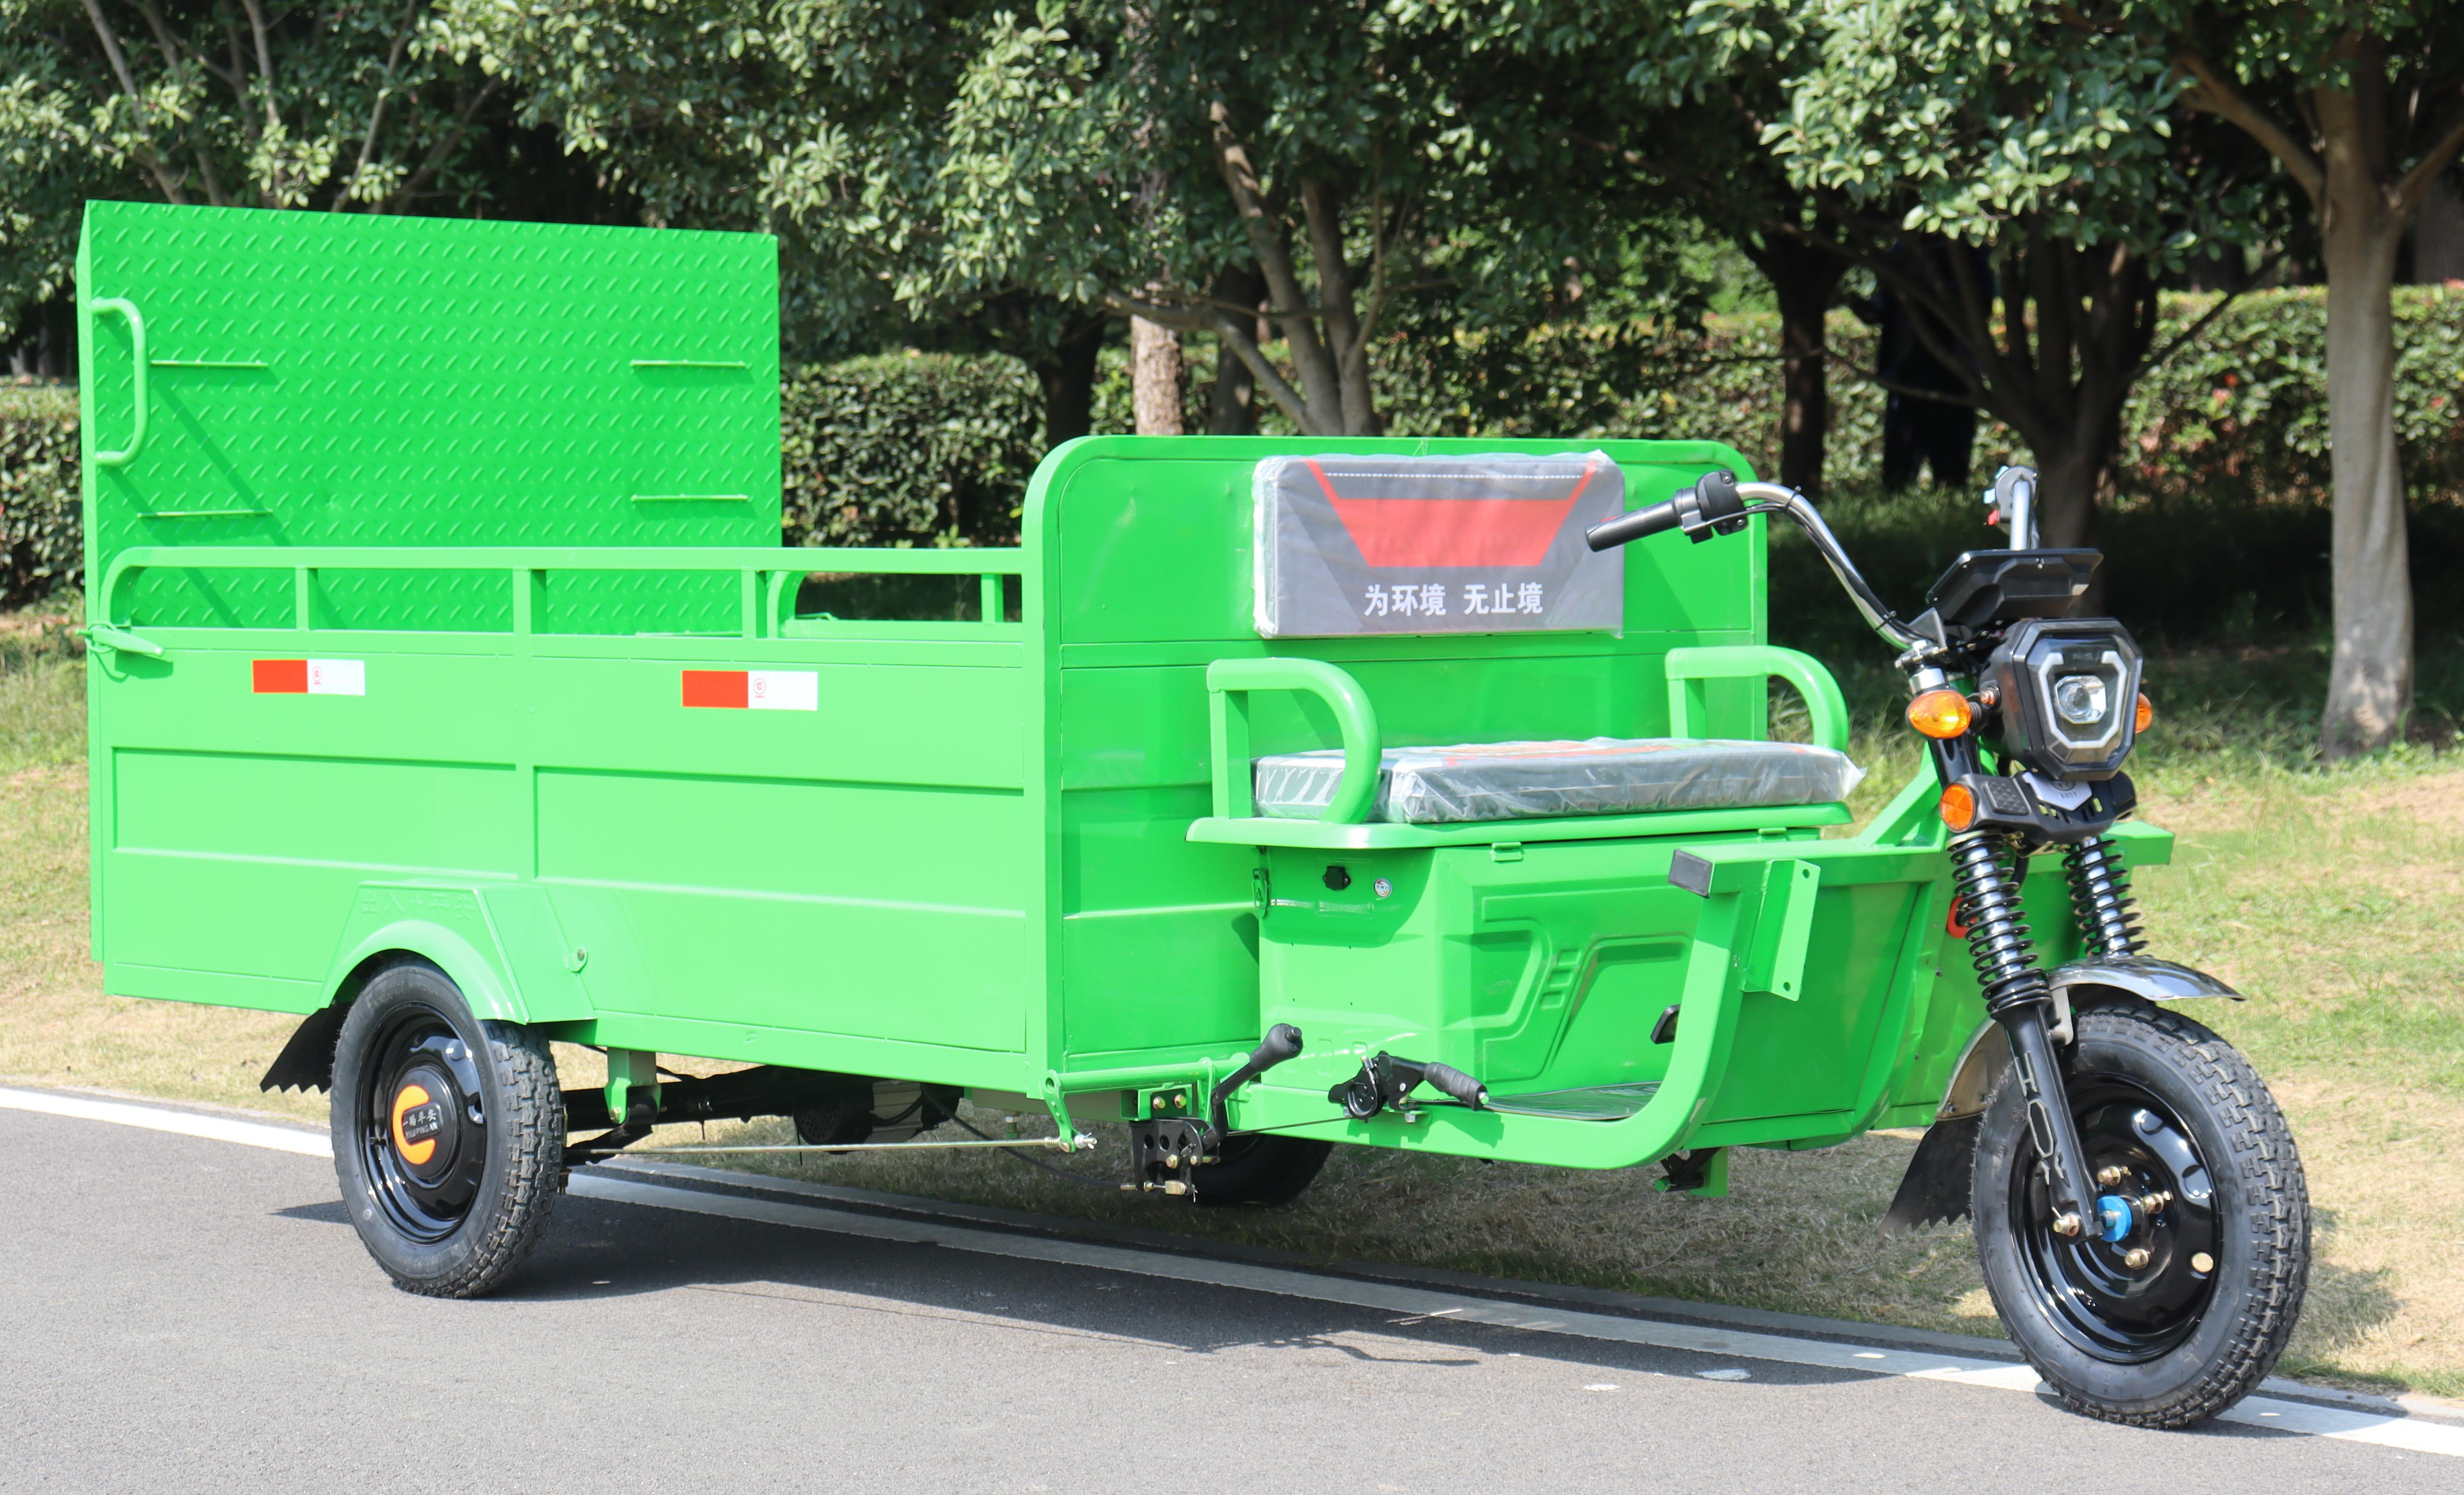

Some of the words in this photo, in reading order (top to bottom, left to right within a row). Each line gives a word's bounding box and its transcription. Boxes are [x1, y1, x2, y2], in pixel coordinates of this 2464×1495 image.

[1364, 583, 1447, 617] 为环境
[1463, 582, 1544, 615] 无止境
